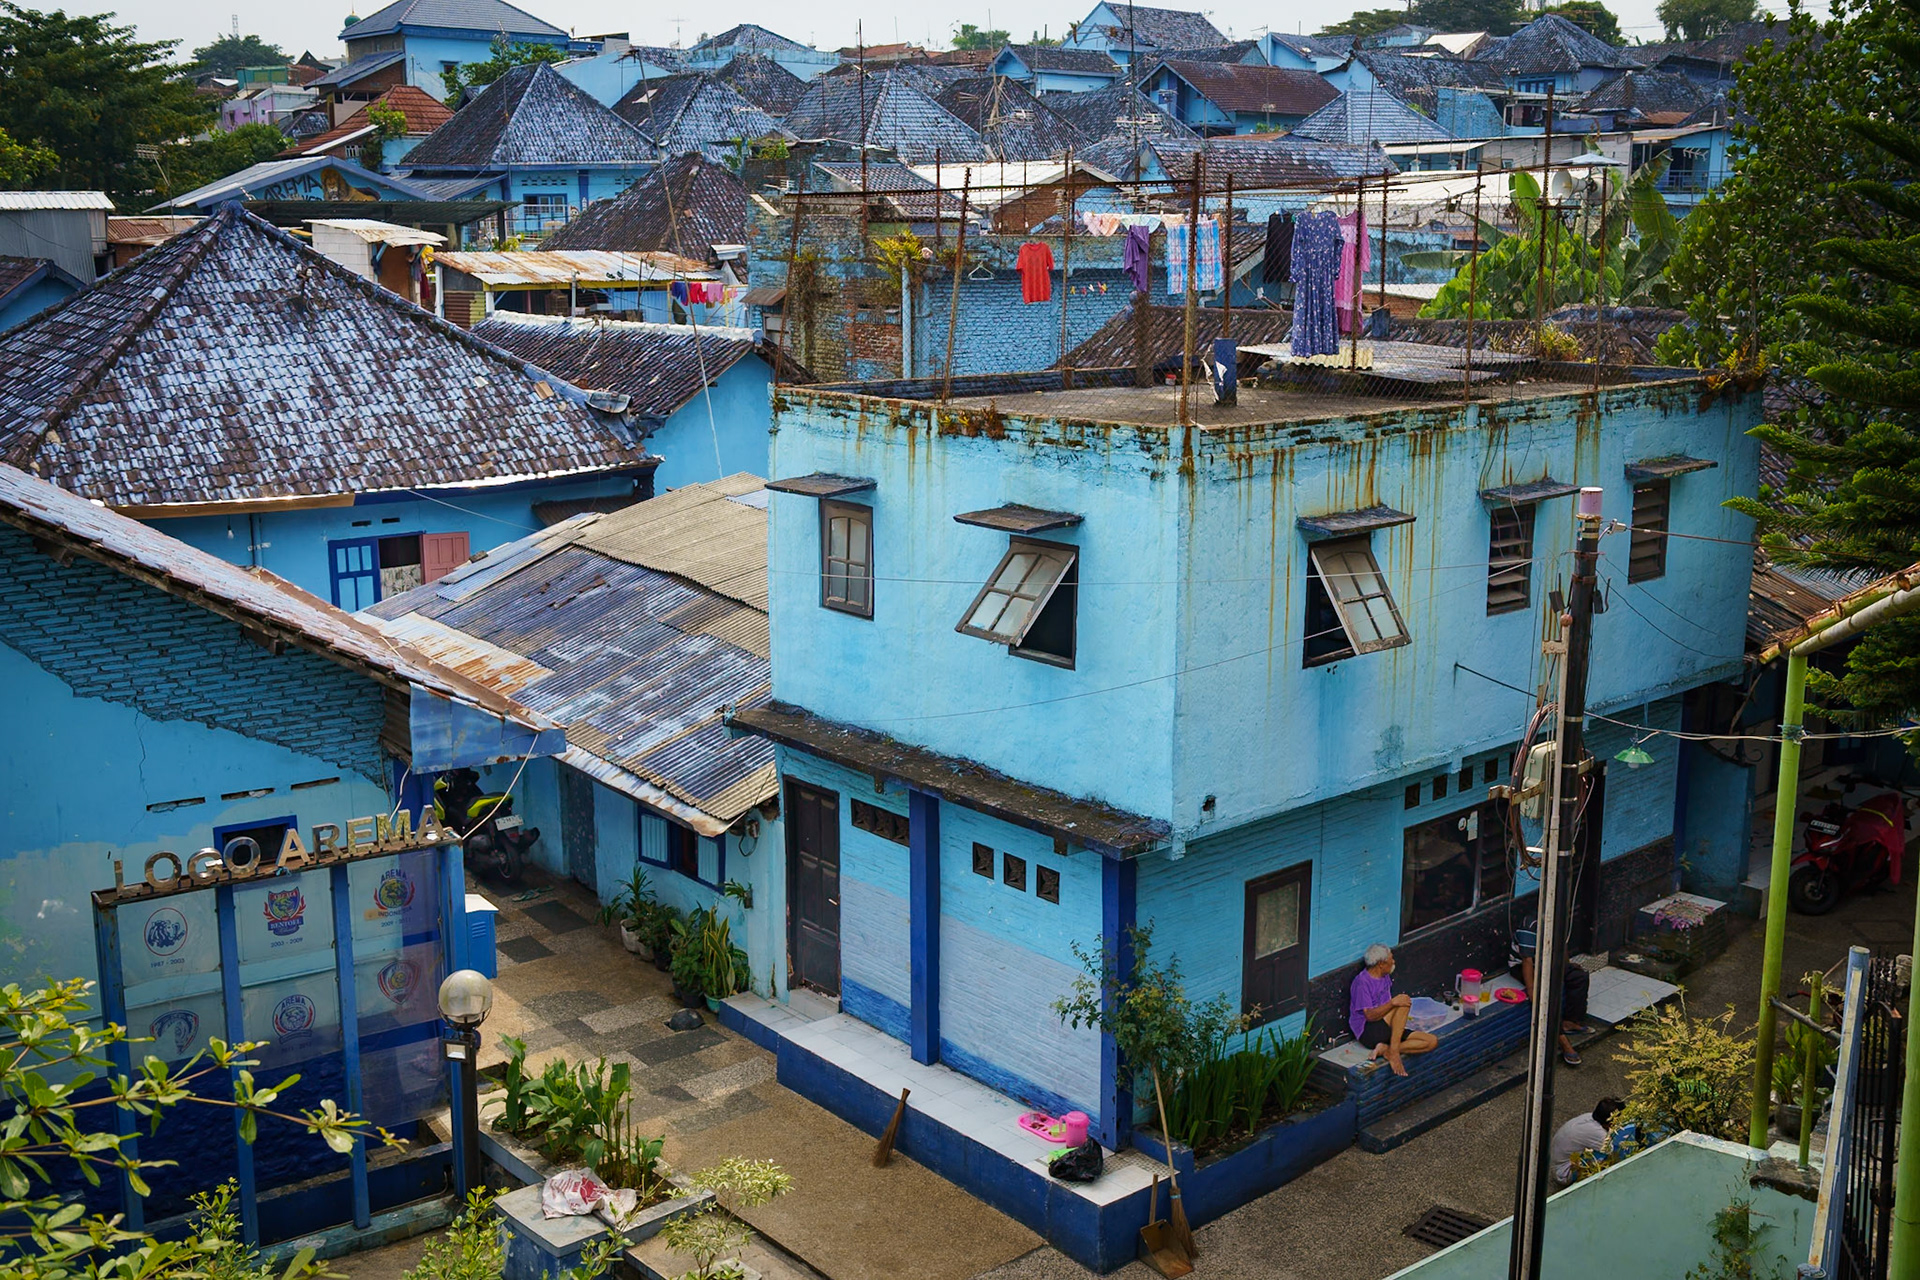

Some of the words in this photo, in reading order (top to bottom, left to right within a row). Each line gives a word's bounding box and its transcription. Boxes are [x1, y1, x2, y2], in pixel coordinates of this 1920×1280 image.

[114, 836, 261, 897] LOGO
[274, 804, 446, 867] AREMA
[381, 869, 407, 884] AREMA
[281, 996, 306, 1010] AREMA
